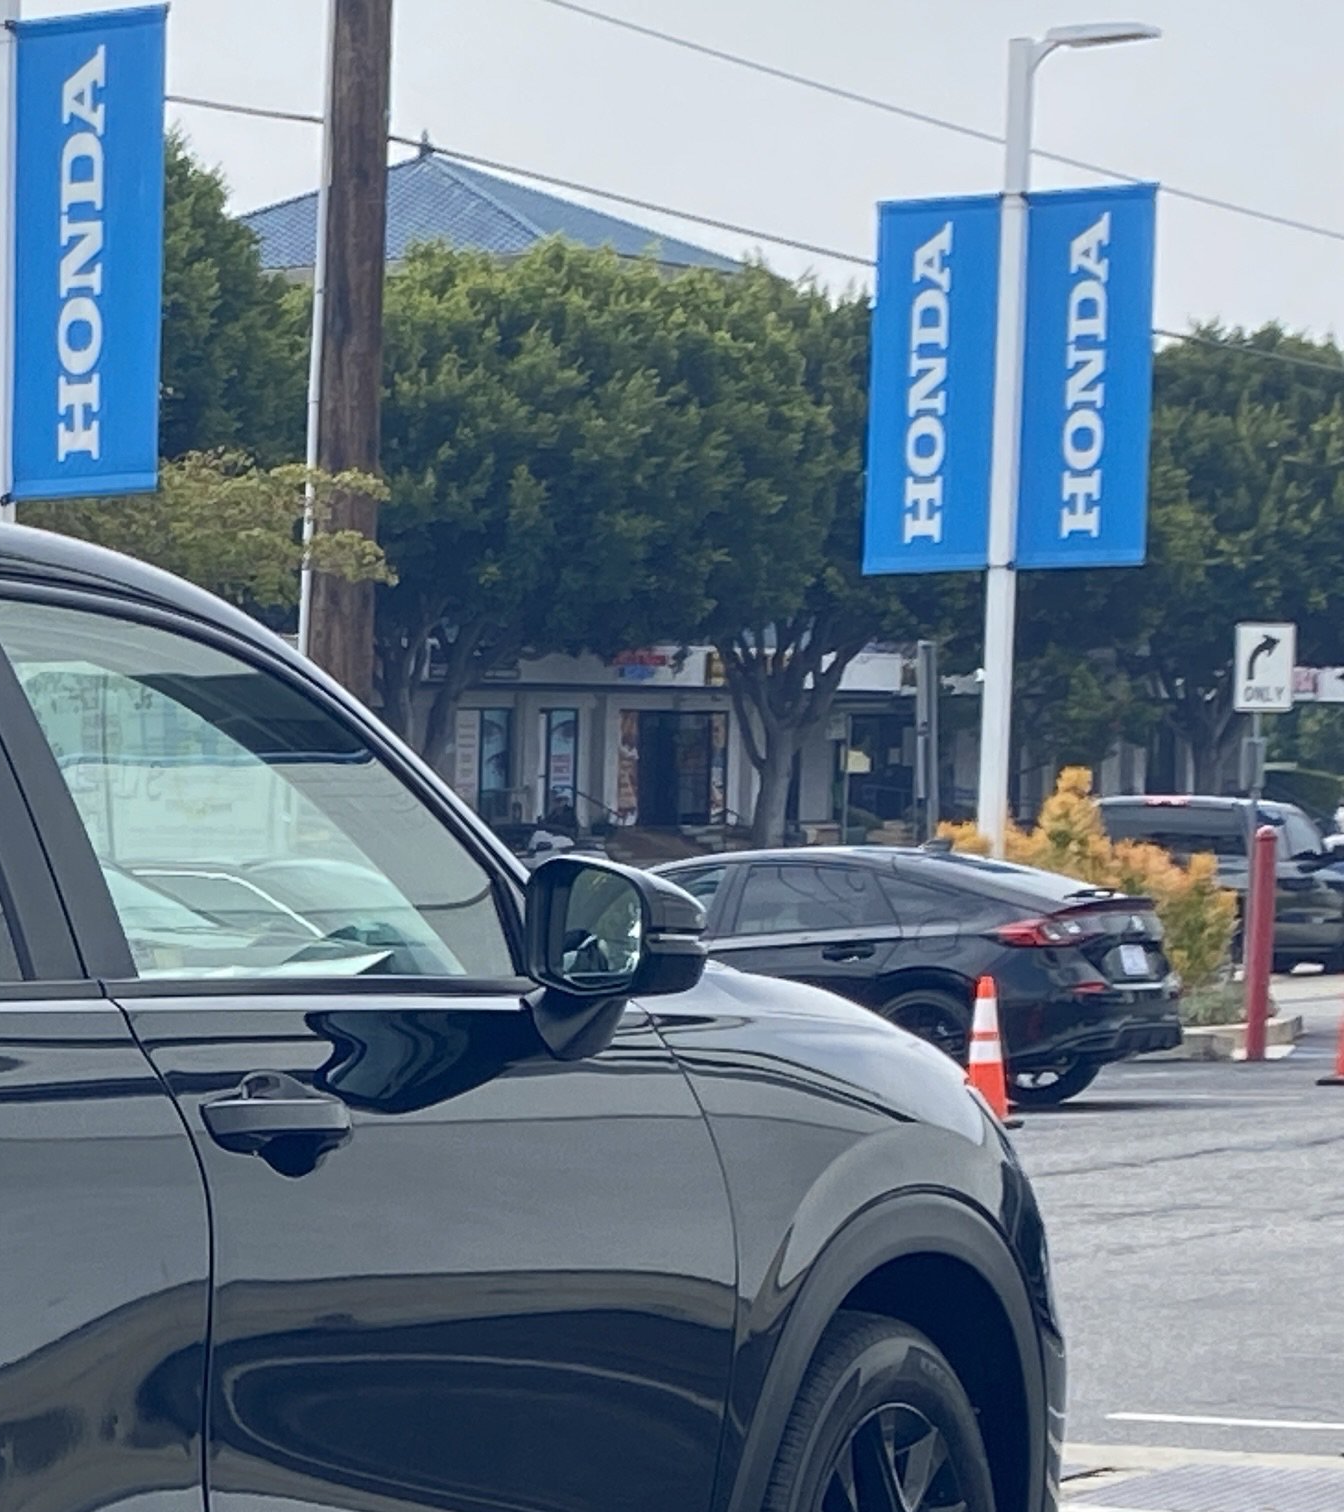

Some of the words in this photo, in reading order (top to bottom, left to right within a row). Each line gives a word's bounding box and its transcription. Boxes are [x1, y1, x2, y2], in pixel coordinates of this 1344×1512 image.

[57, 44, 106, 463] HONDA
[903, 221, 954, 544] HONDA
[1060, 211, 1111, 540] HONDA
[1244, 686, 1285, 702] ONLY
